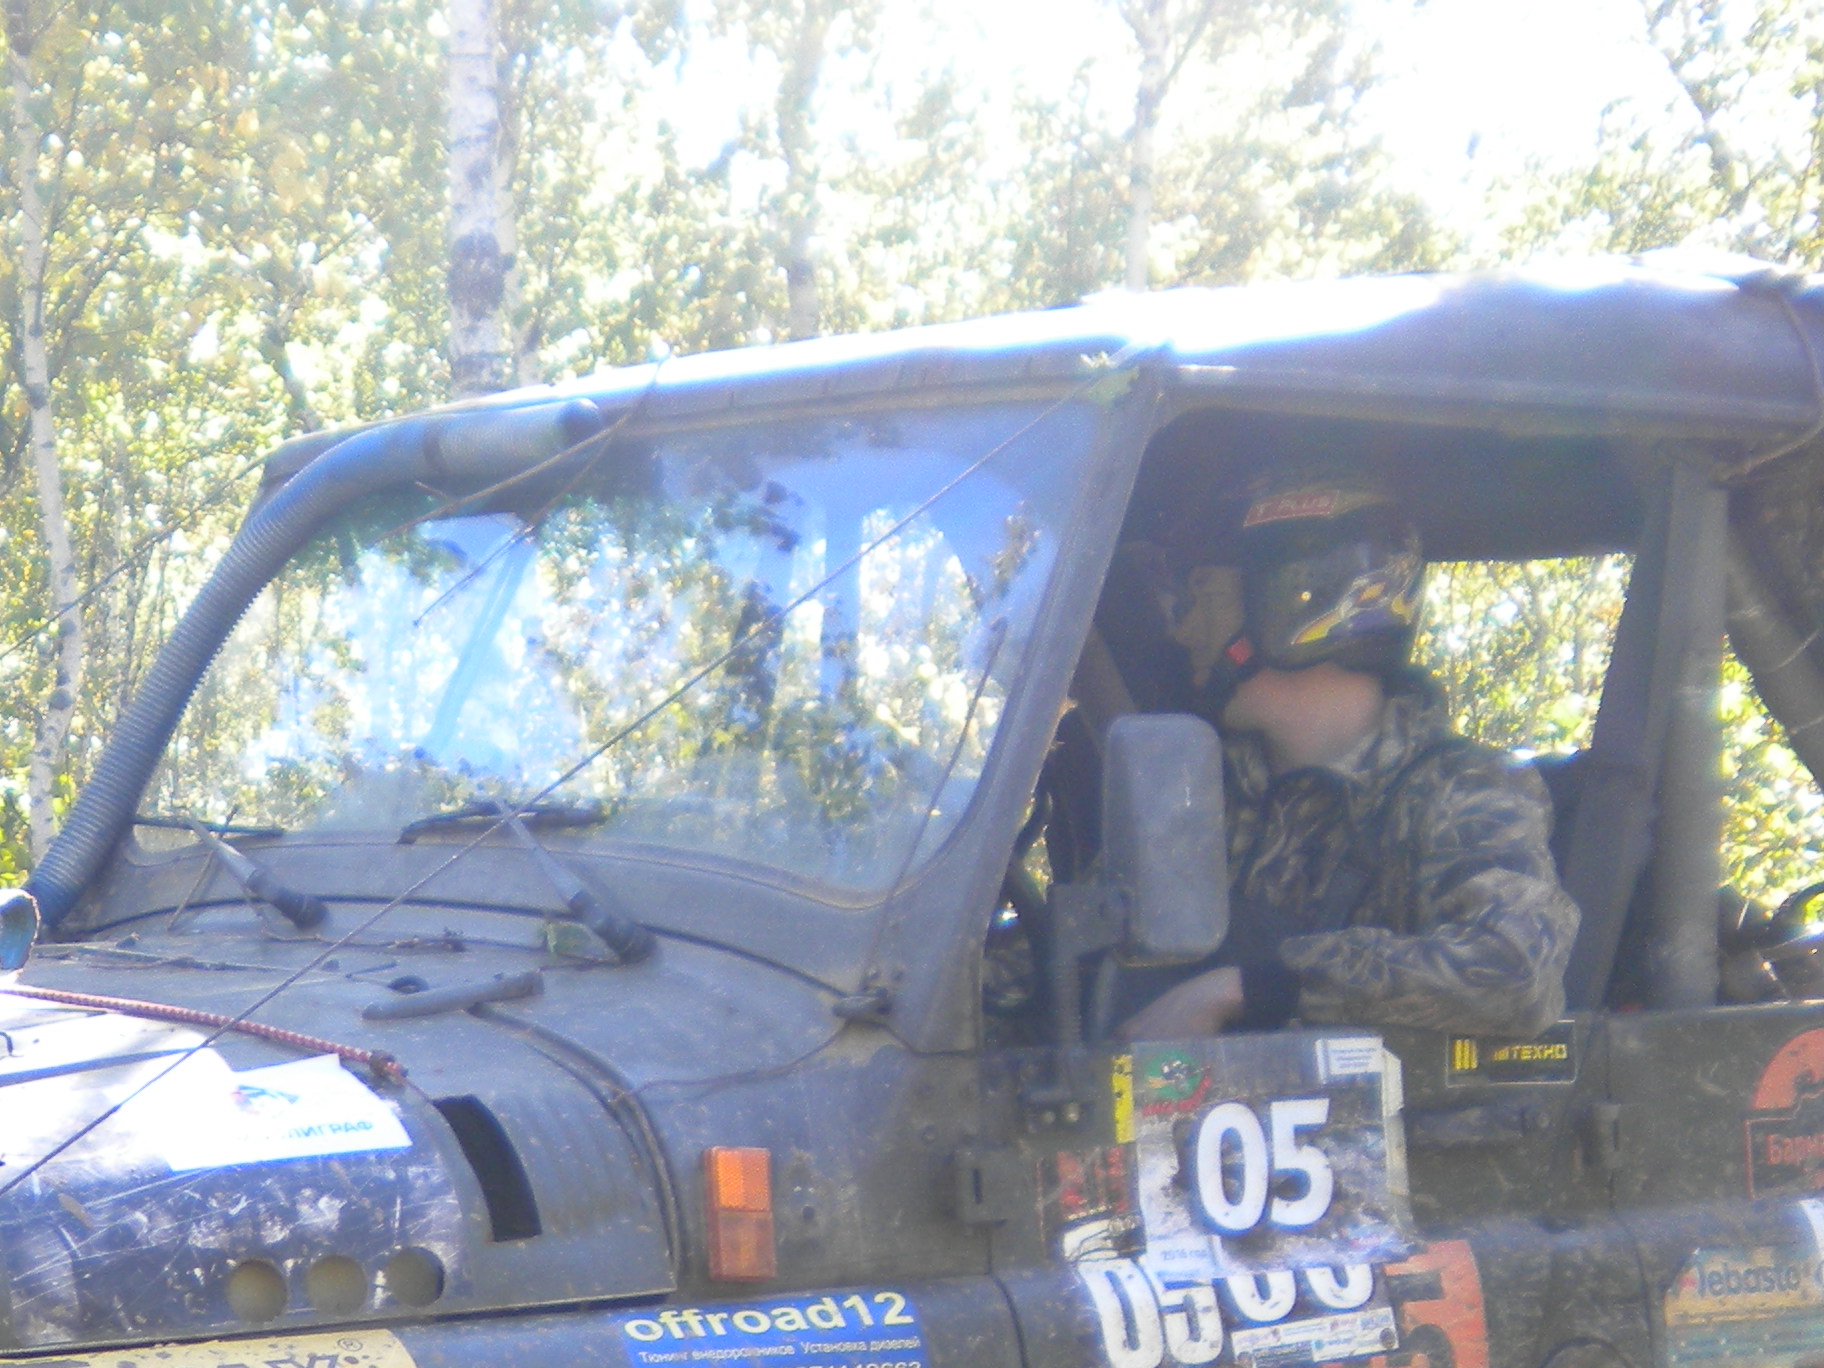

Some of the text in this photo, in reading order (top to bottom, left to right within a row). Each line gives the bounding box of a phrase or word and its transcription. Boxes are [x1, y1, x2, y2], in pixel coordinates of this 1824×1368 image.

[1196, 1097, 1335, 1232] 05
[624, 1291, 915, 1342] offroad12
[638, 1335, 921, 1364] Тюнинг внедорожников Установка дизелей
